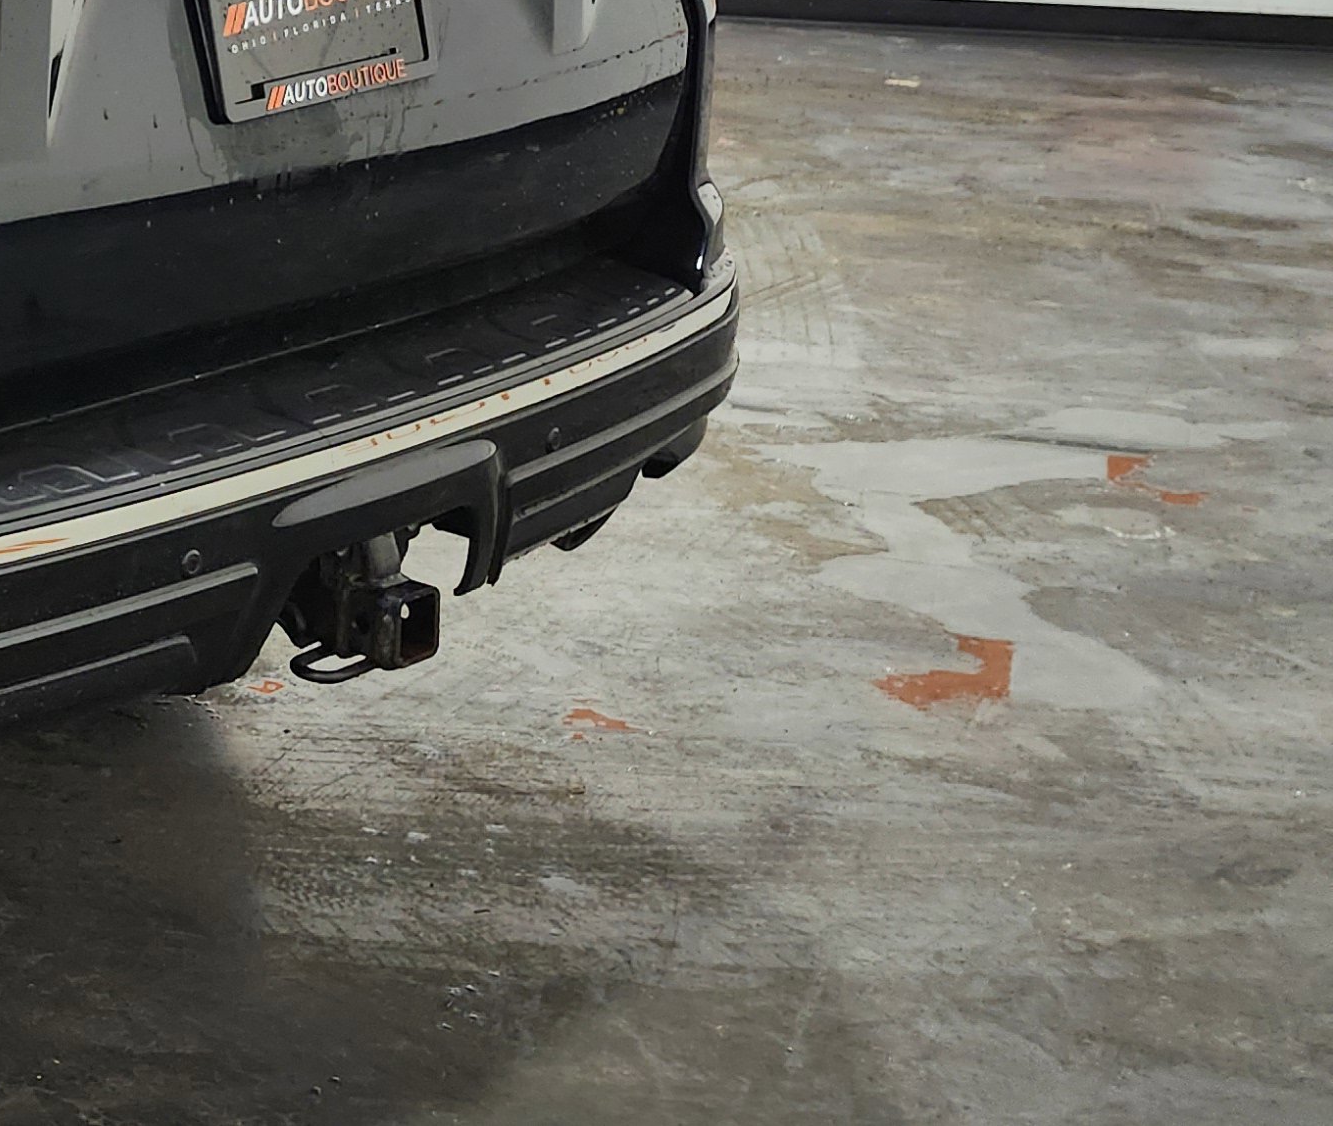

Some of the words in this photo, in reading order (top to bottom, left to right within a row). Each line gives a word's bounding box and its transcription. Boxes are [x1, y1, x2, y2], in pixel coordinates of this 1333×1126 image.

[231, 35, 268, 54] OHIO
[283, 12, 347, 38] FLORIDA
[282, 58, 408, 107] AUTOBOUTIQUE
